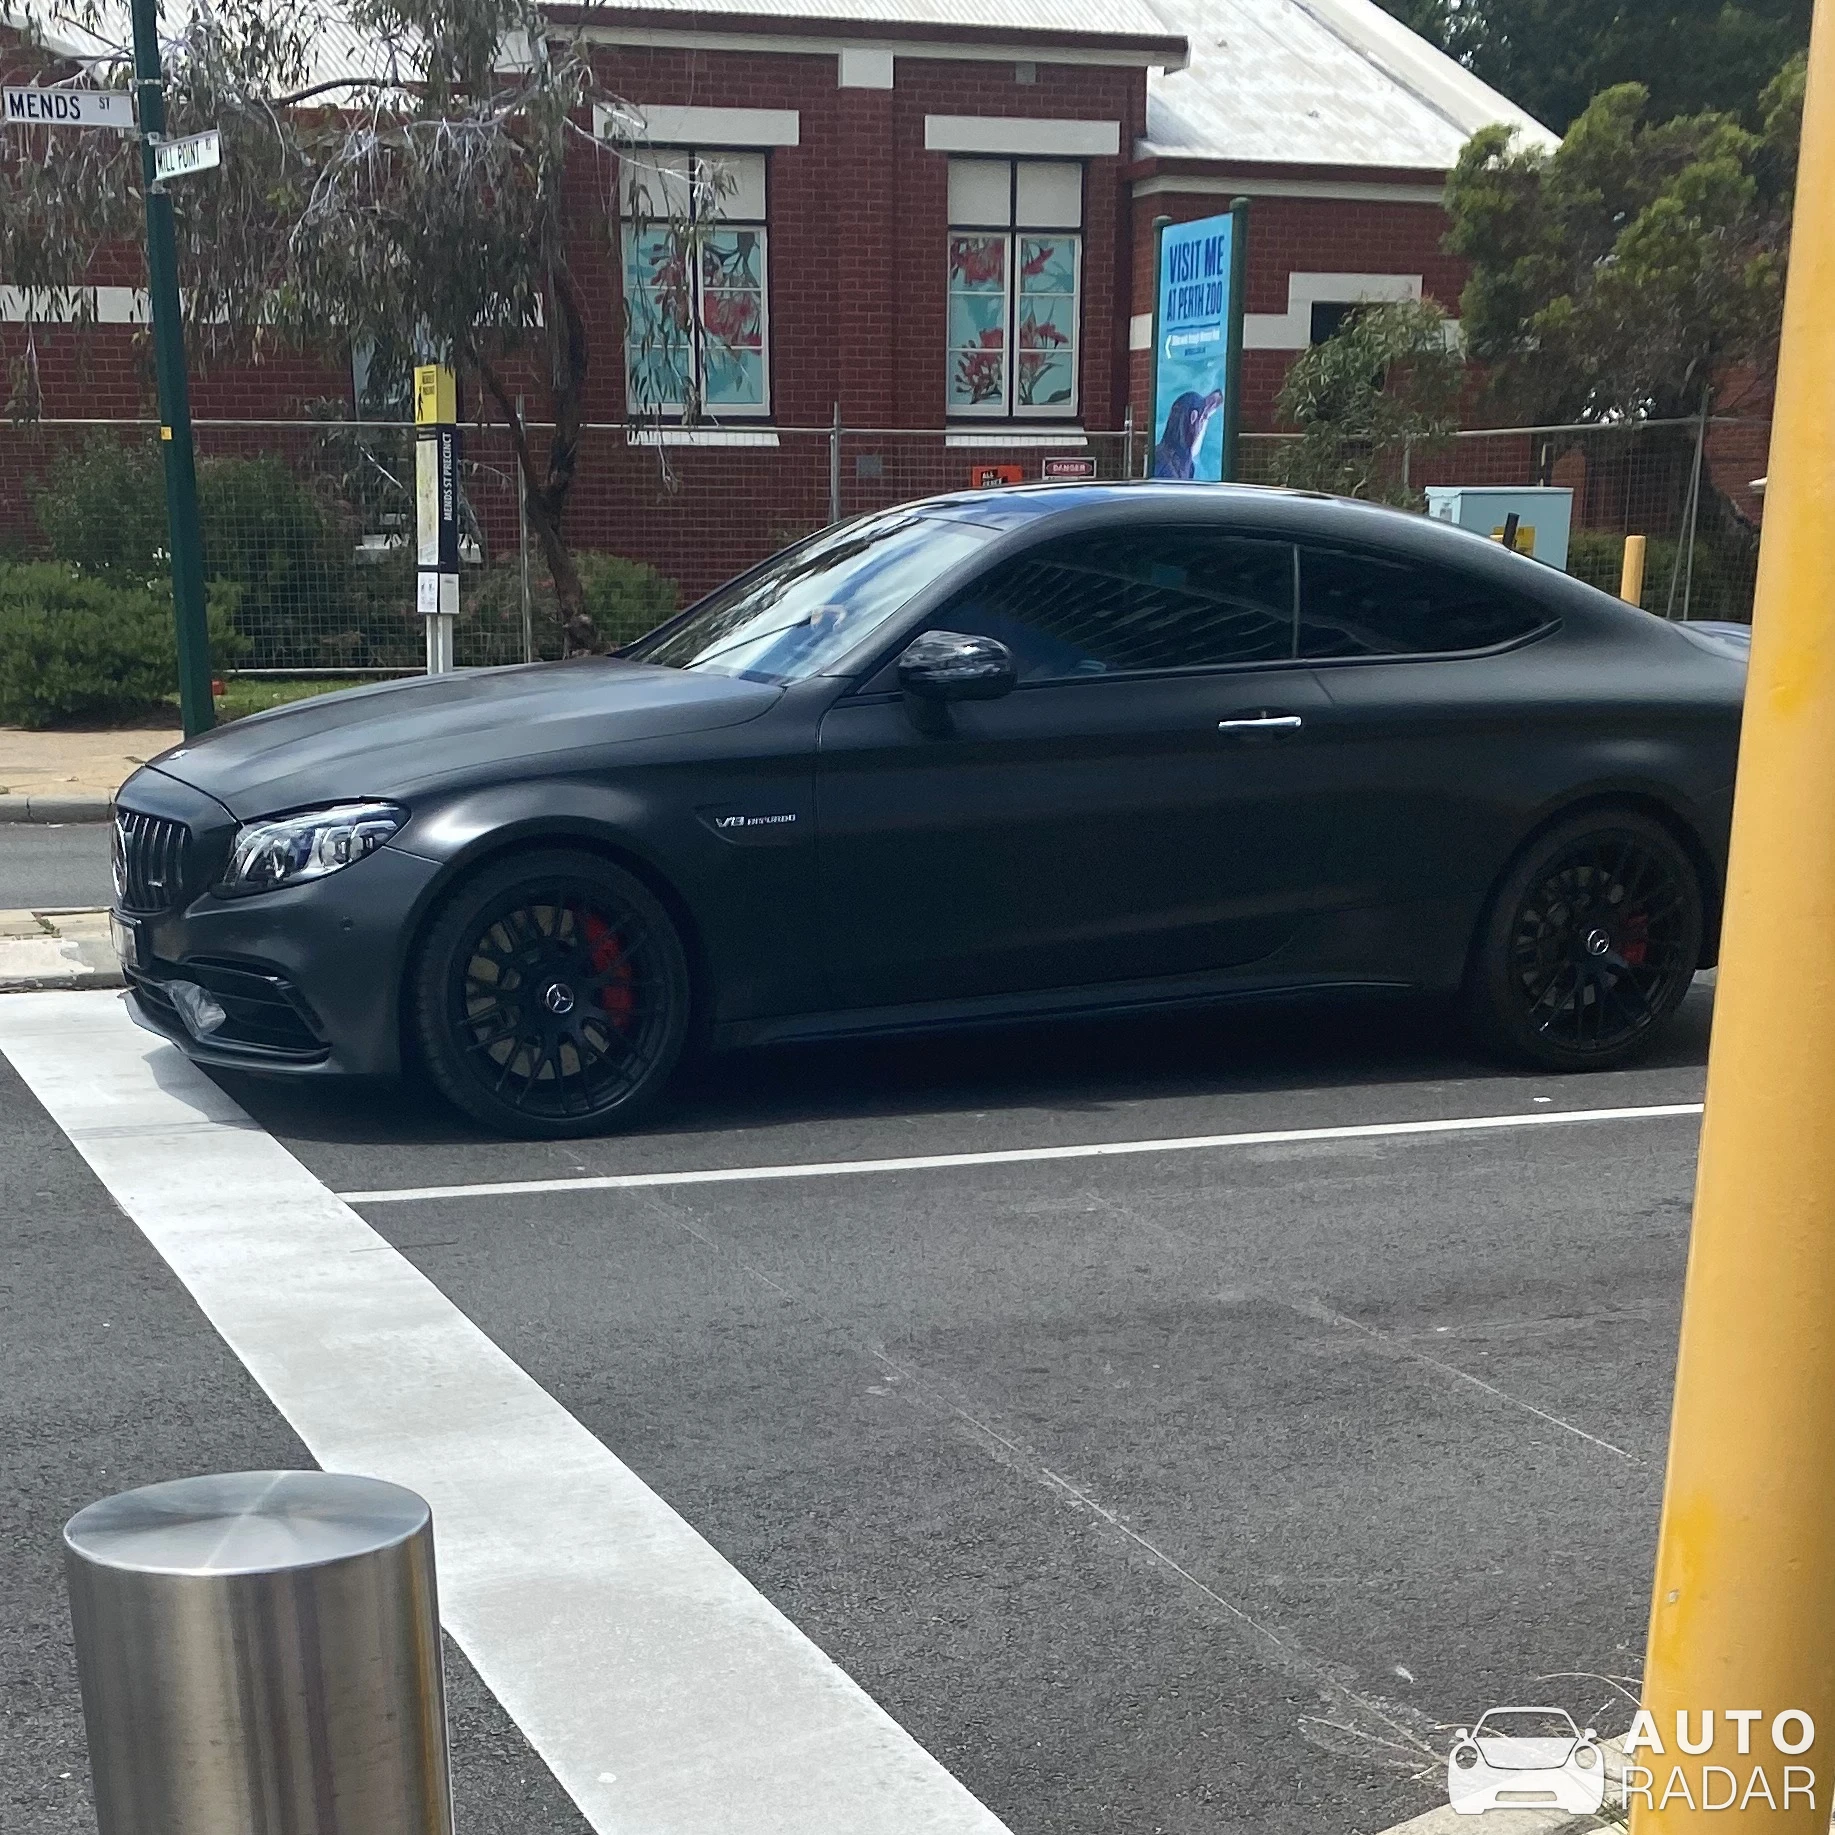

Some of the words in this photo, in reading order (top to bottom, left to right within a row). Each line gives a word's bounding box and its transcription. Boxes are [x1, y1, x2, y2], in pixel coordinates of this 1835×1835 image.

[9, 93, 81, 120] MENDS
[99, 96, 110, 111] ST
[157, 147, 175, 174] MILL
[177, 140, 200, 170] POINT
[1169, 239, 1202, 284] VISIT
[1204, 235, 1225, 278] ME
[1167, 288, 1177, 322] AT
[1178, 283, 1204, 320] PERTH
[1205, 280, 1223, 316] ZOO
[442, 432, 452, 476] PRECINCT
[1052, 464, 1086, 473] DANGER
[443, 476, 453, 488] ST
[443, 488, 453, 521] MENDS
[715, 816, 745, 828] V8
